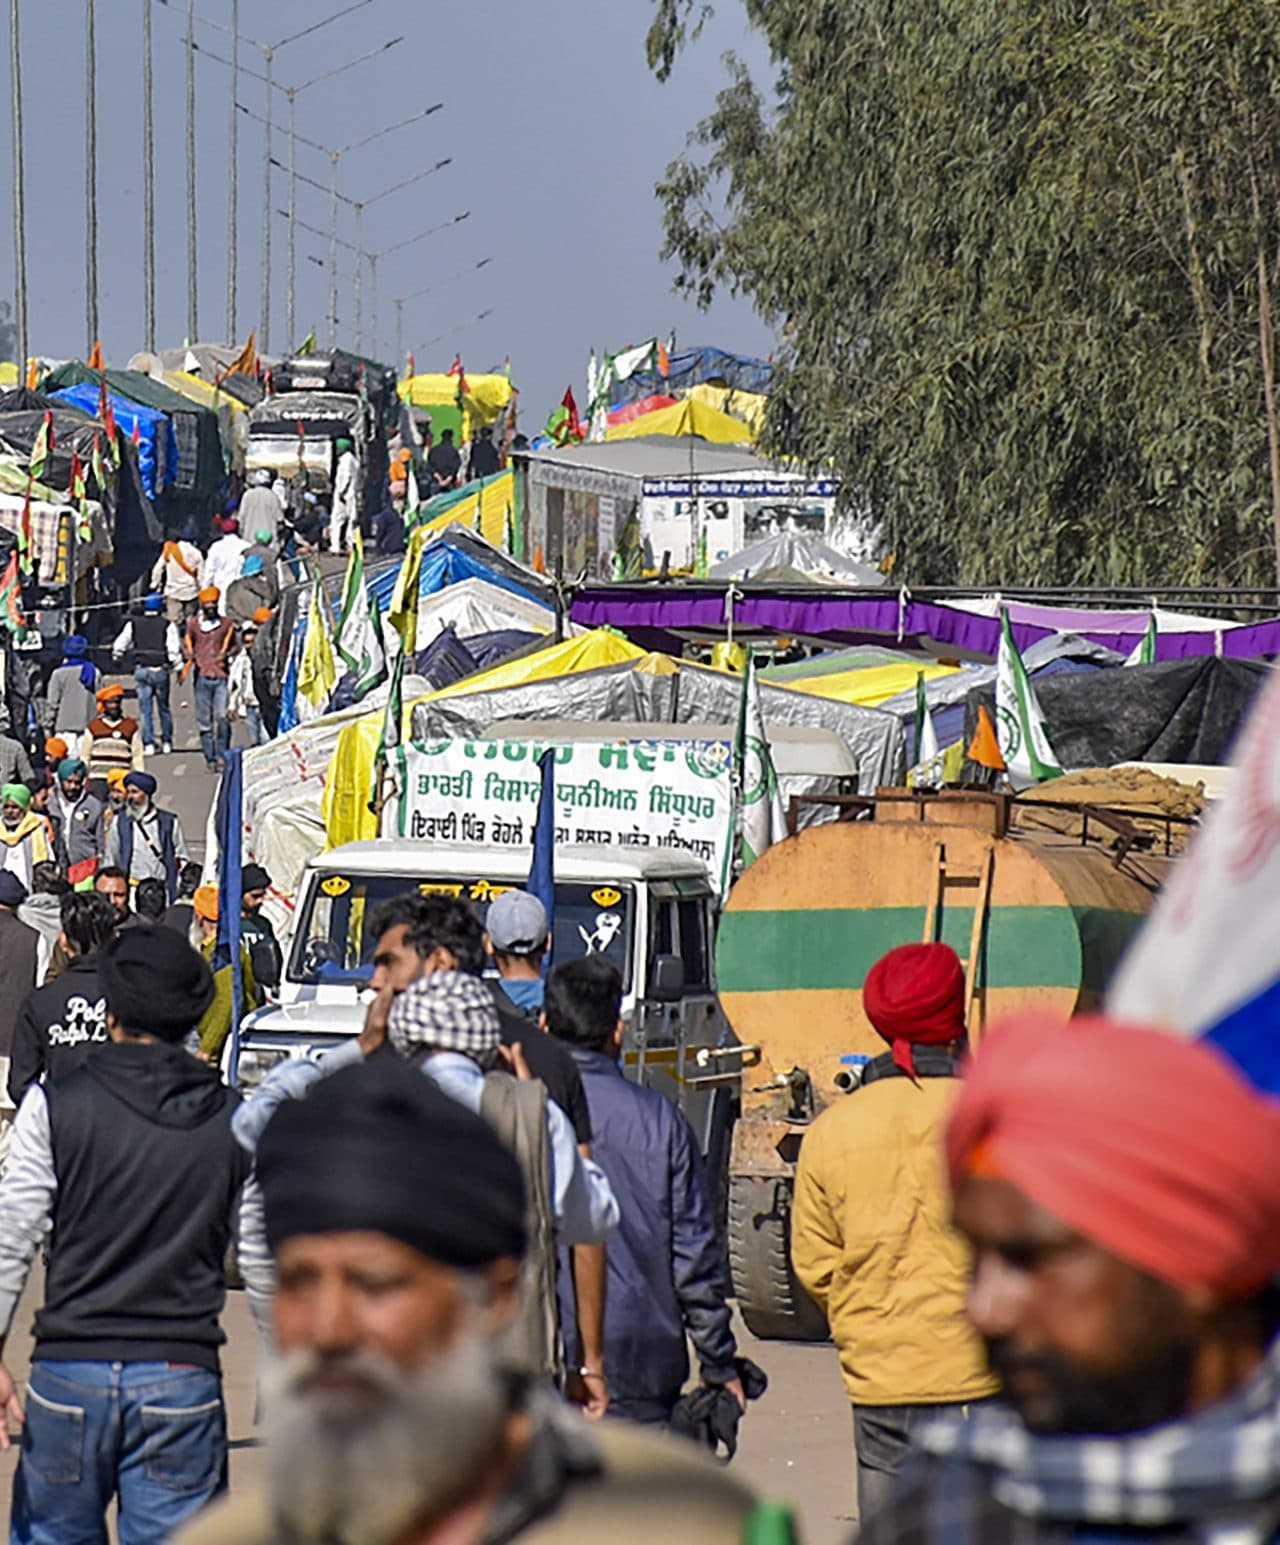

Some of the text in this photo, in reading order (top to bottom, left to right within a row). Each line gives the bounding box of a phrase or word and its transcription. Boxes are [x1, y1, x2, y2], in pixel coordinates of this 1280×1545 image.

[417, 769, 473, 800] ਭਾਰਤੀ
[556, 778, 639, 818] ਯੂਨੀਅਨ
[410, 809, 457, 840] ਇਕਾਈ
[64, 995, 107, 1023] Pol
[48, 1022, 108, 1047] Ralph L
